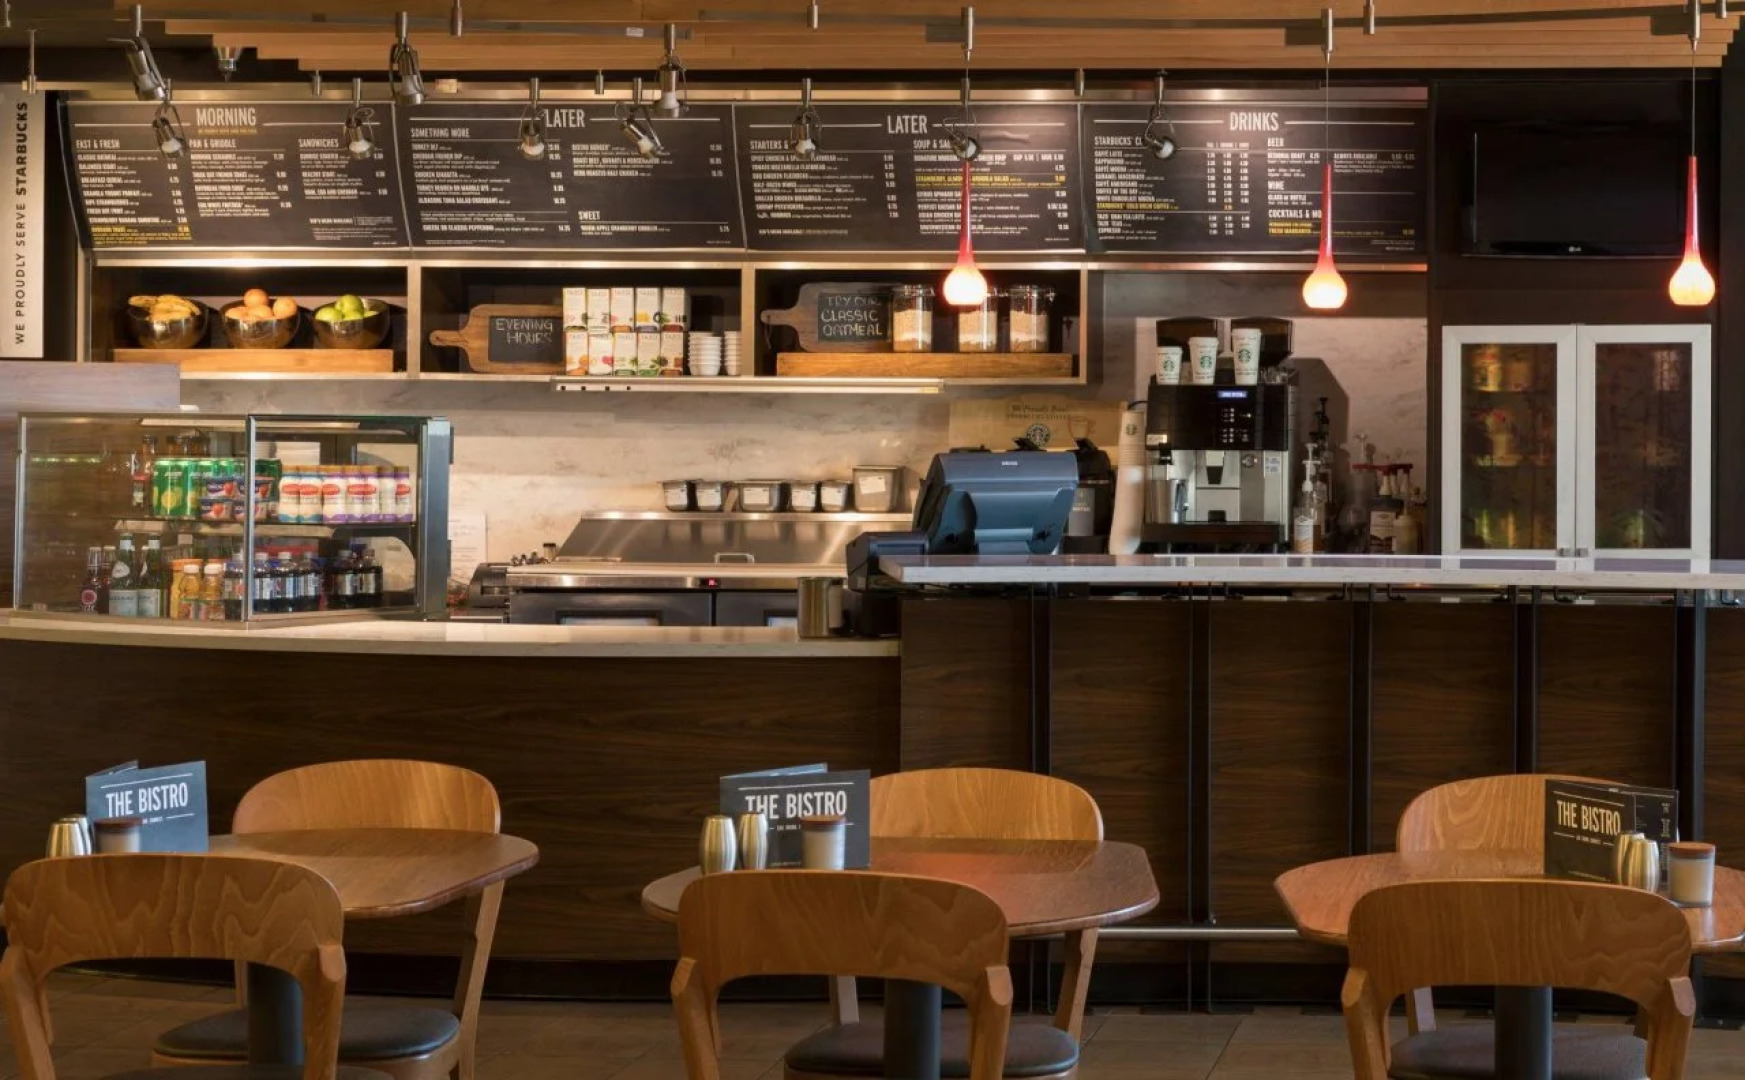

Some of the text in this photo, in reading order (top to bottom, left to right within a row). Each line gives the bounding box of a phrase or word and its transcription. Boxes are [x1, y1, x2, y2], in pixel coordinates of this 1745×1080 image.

[196, 108, 257, 126] MORNING
[545, 109, 585, 127] LATER
[1230, 112, 1279, 131] DRINKS
[888, 115, 928, 134] LATER
[411, 128, 470, 138] SOMETHING MORE
[76, 139, 91, 149] FAST
[99, 139, 120, 149] FRESH
[210, 139, 237, 148] GRIDDLE
[299, 138, 339, 148] SANDWICHES
[750, 140, 782, 150] STARTERS
[913, 140, 930, 149] SOUP
[1094, 136, 1132, 146] STARBUCKS
[1267, 138, 1284, 147] BEER
[1267, 181, 1285, 190] WINE
[578, 211, 600, 220] SWEET
[1268, 210, 1303, 219] COCKTAILS
[15, 101, 28, 345] WE PROUDLY SERVE STARBUCKS
[827, 295, 852, 307] TRY
[821, 309, 879, 323] CLASSIC
[495, 318, 553, 331] EVENING
[823, 322, 884, 337] OATMEAL
[507, 331, 553, 345] HOURS
[105, 782, 189, 818] THE BISTRO
[745, 790, 847, 820] THE BISTRO
[1556, 800, 1621, 836] THE BISTRO
